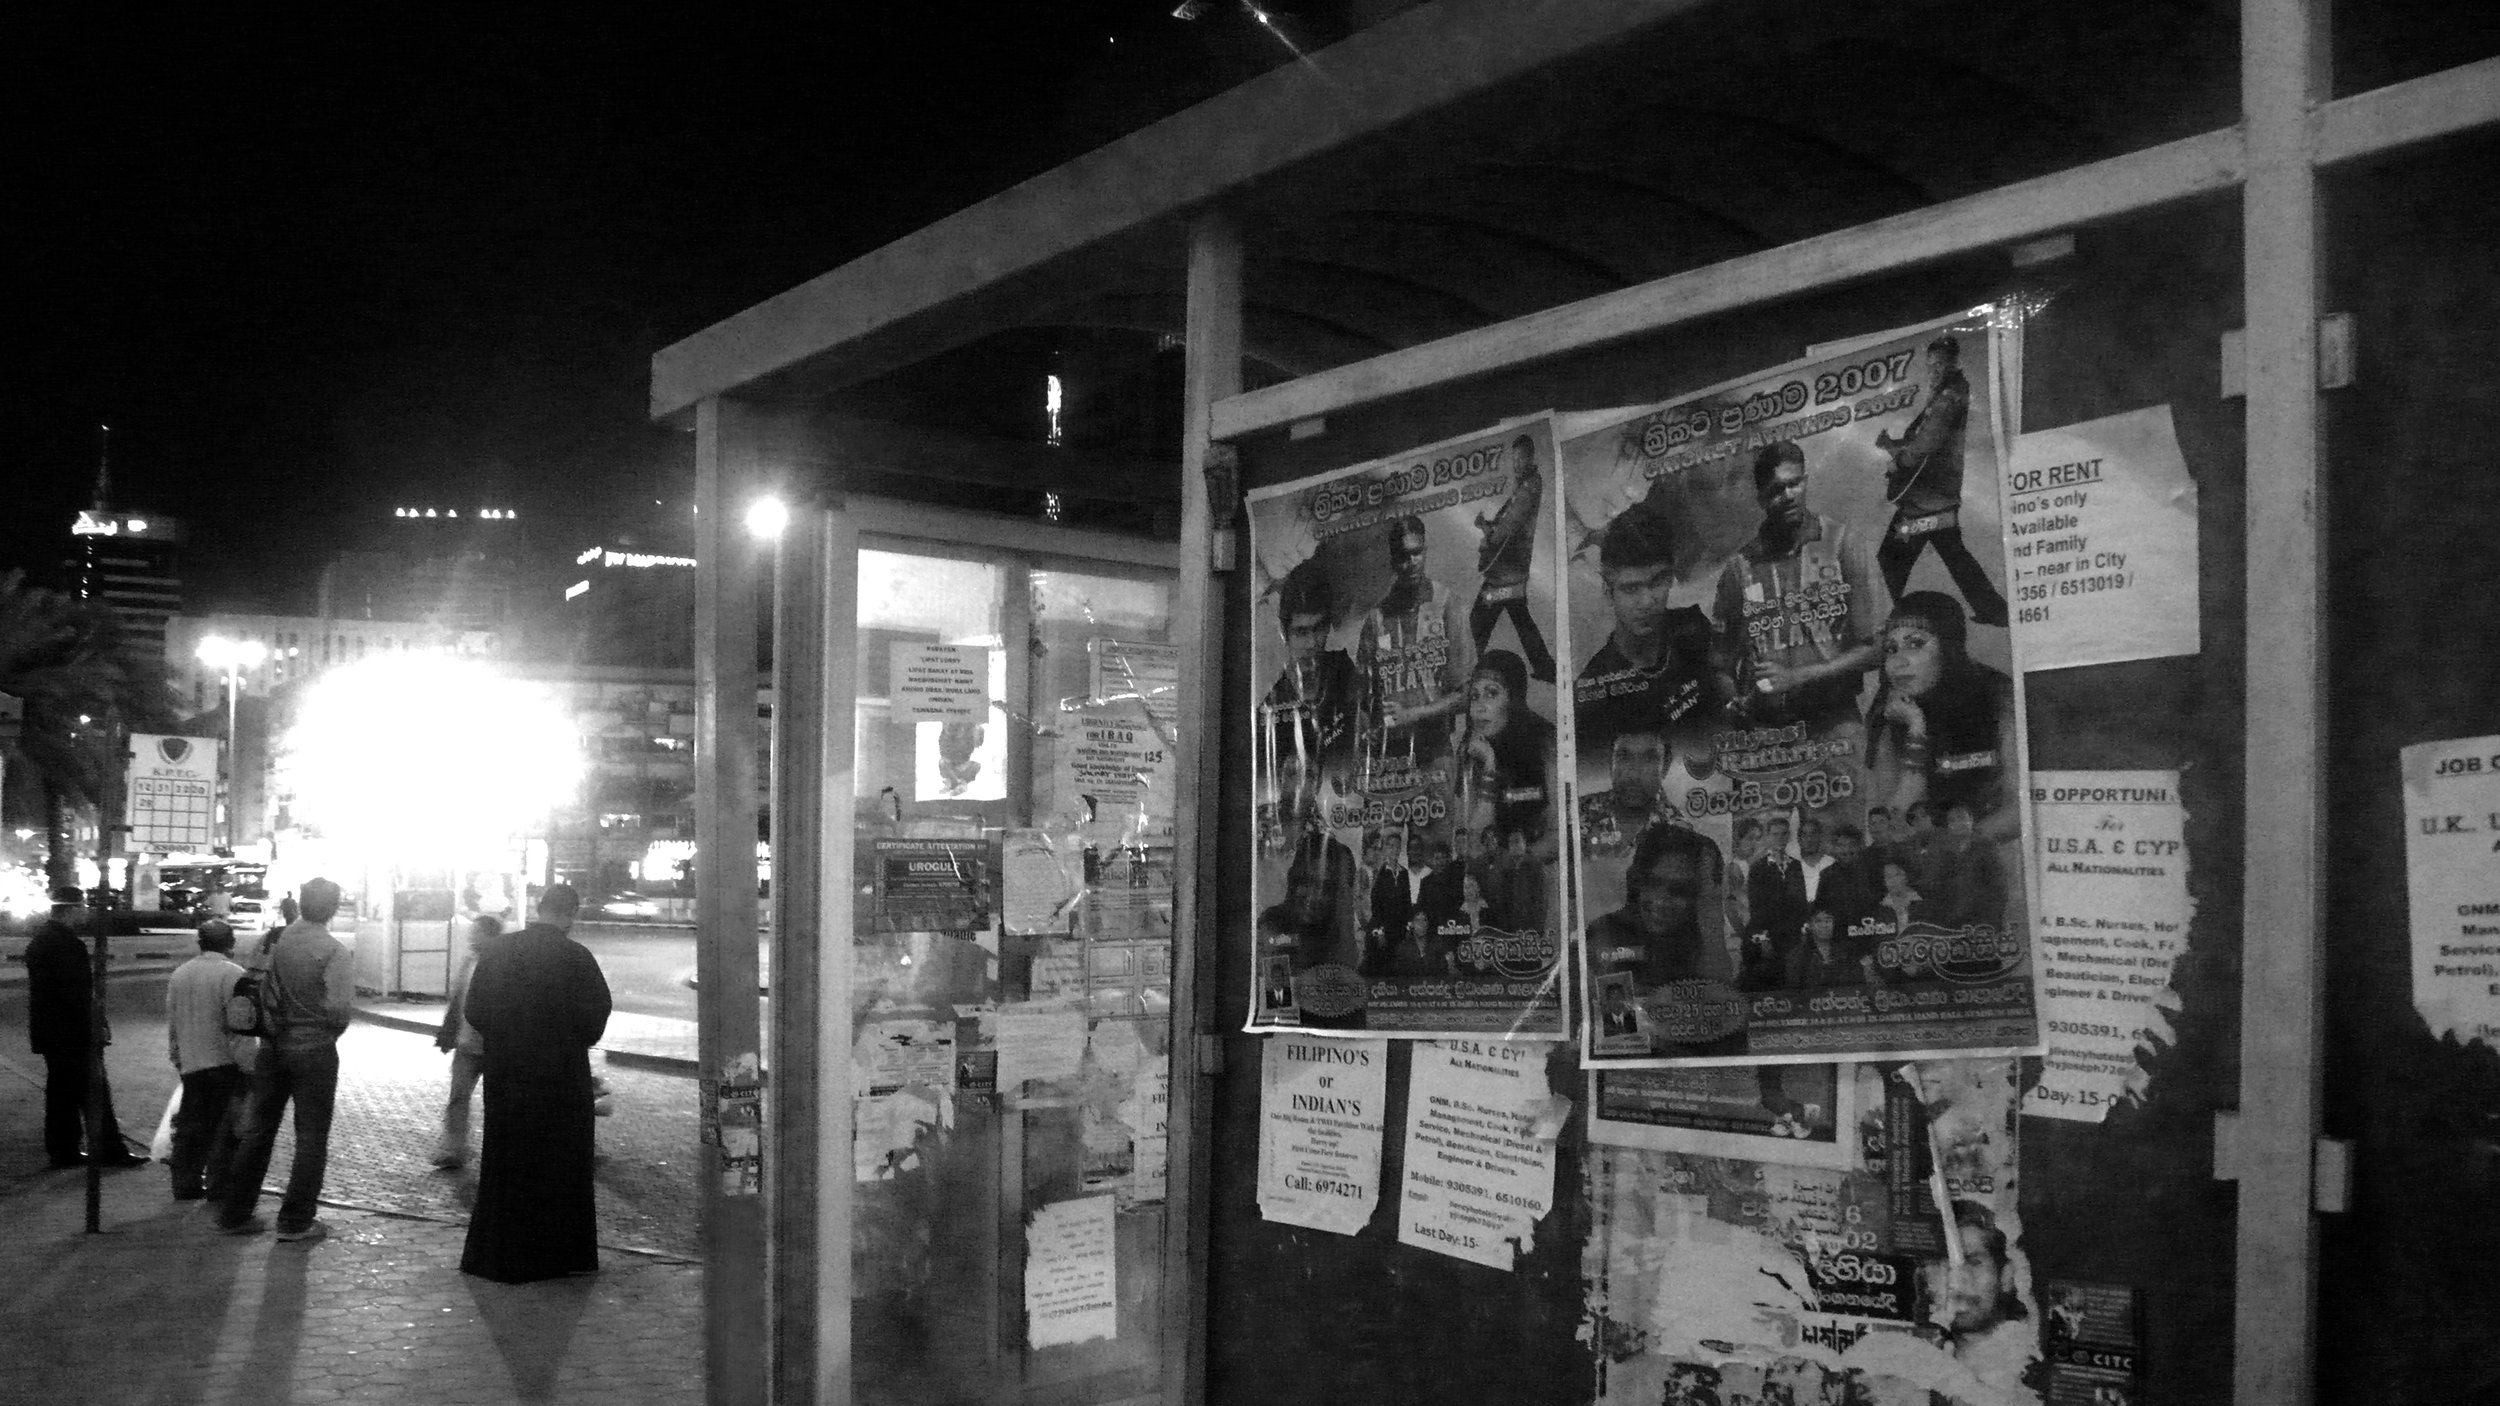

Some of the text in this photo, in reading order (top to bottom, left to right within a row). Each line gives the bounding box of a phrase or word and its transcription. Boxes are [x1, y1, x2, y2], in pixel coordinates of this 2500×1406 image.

[1815, 350, 1914, 405] 2007
[1854, 384, 1920, 421] 2007
[1433, 443, 1505, 487] 2007
[2008, 458, 2103, 490] OR RENT
[2010, 490, 2087, 514] ino's only
[2037, 535, 2087, 555] Family
[2038, 552, 2127, 576] near in City
[2060, 573, 2125, 596] 6513019
[1144, 750, 1163, 763] 125
[2435, 757, 2481, 775] JOB
[2057, 952, 2137, 967] Mechanical
[1287, 1044, 1369, 1066] FILIPINO'S
[1319, 1076, 1334, 1089] or
[1292, 1094, 1361, 1117] INDIAN'S
[1437, 1151, 1475, 1167] Engineer
[1285, 1174, 1312, 1191] Call:
[1315, 1180, 1362, 1200] 6974271
[1410, 1171, 1444, 1188] Mobile:
[1414, 1222, 1437, 1239] Last
[2093, 1353, 2132, 1368] CITC
